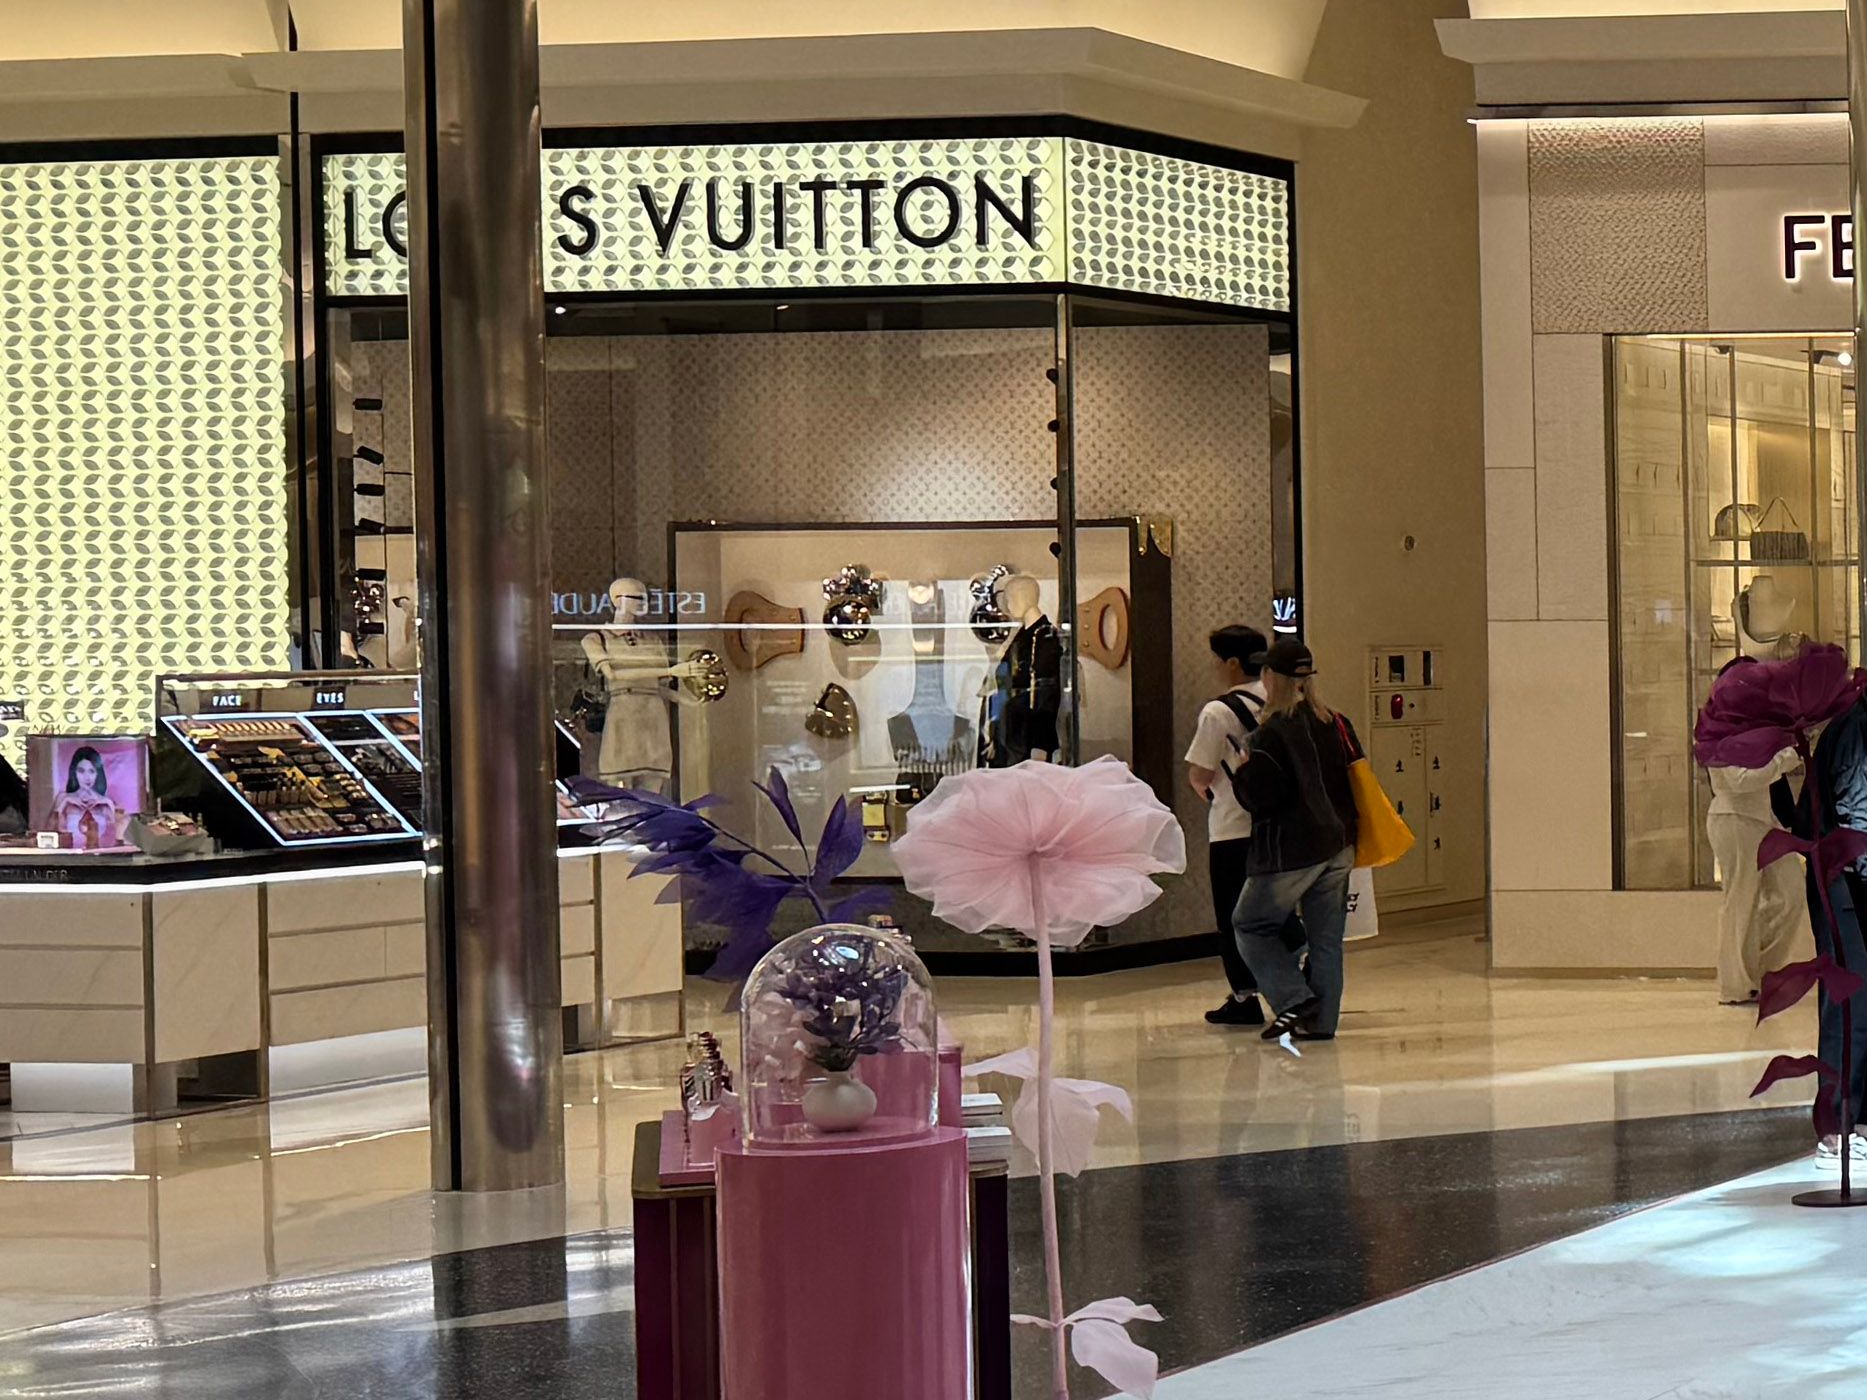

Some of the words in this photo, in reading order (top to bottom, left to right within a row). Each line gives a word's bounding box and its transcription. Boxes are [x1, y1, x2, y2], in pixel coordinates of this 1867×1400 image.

[638, 175, 1038, 257] VUITTON
[212, 694, 242, 707] FACE
[316, 691, 344, 704] EYES
